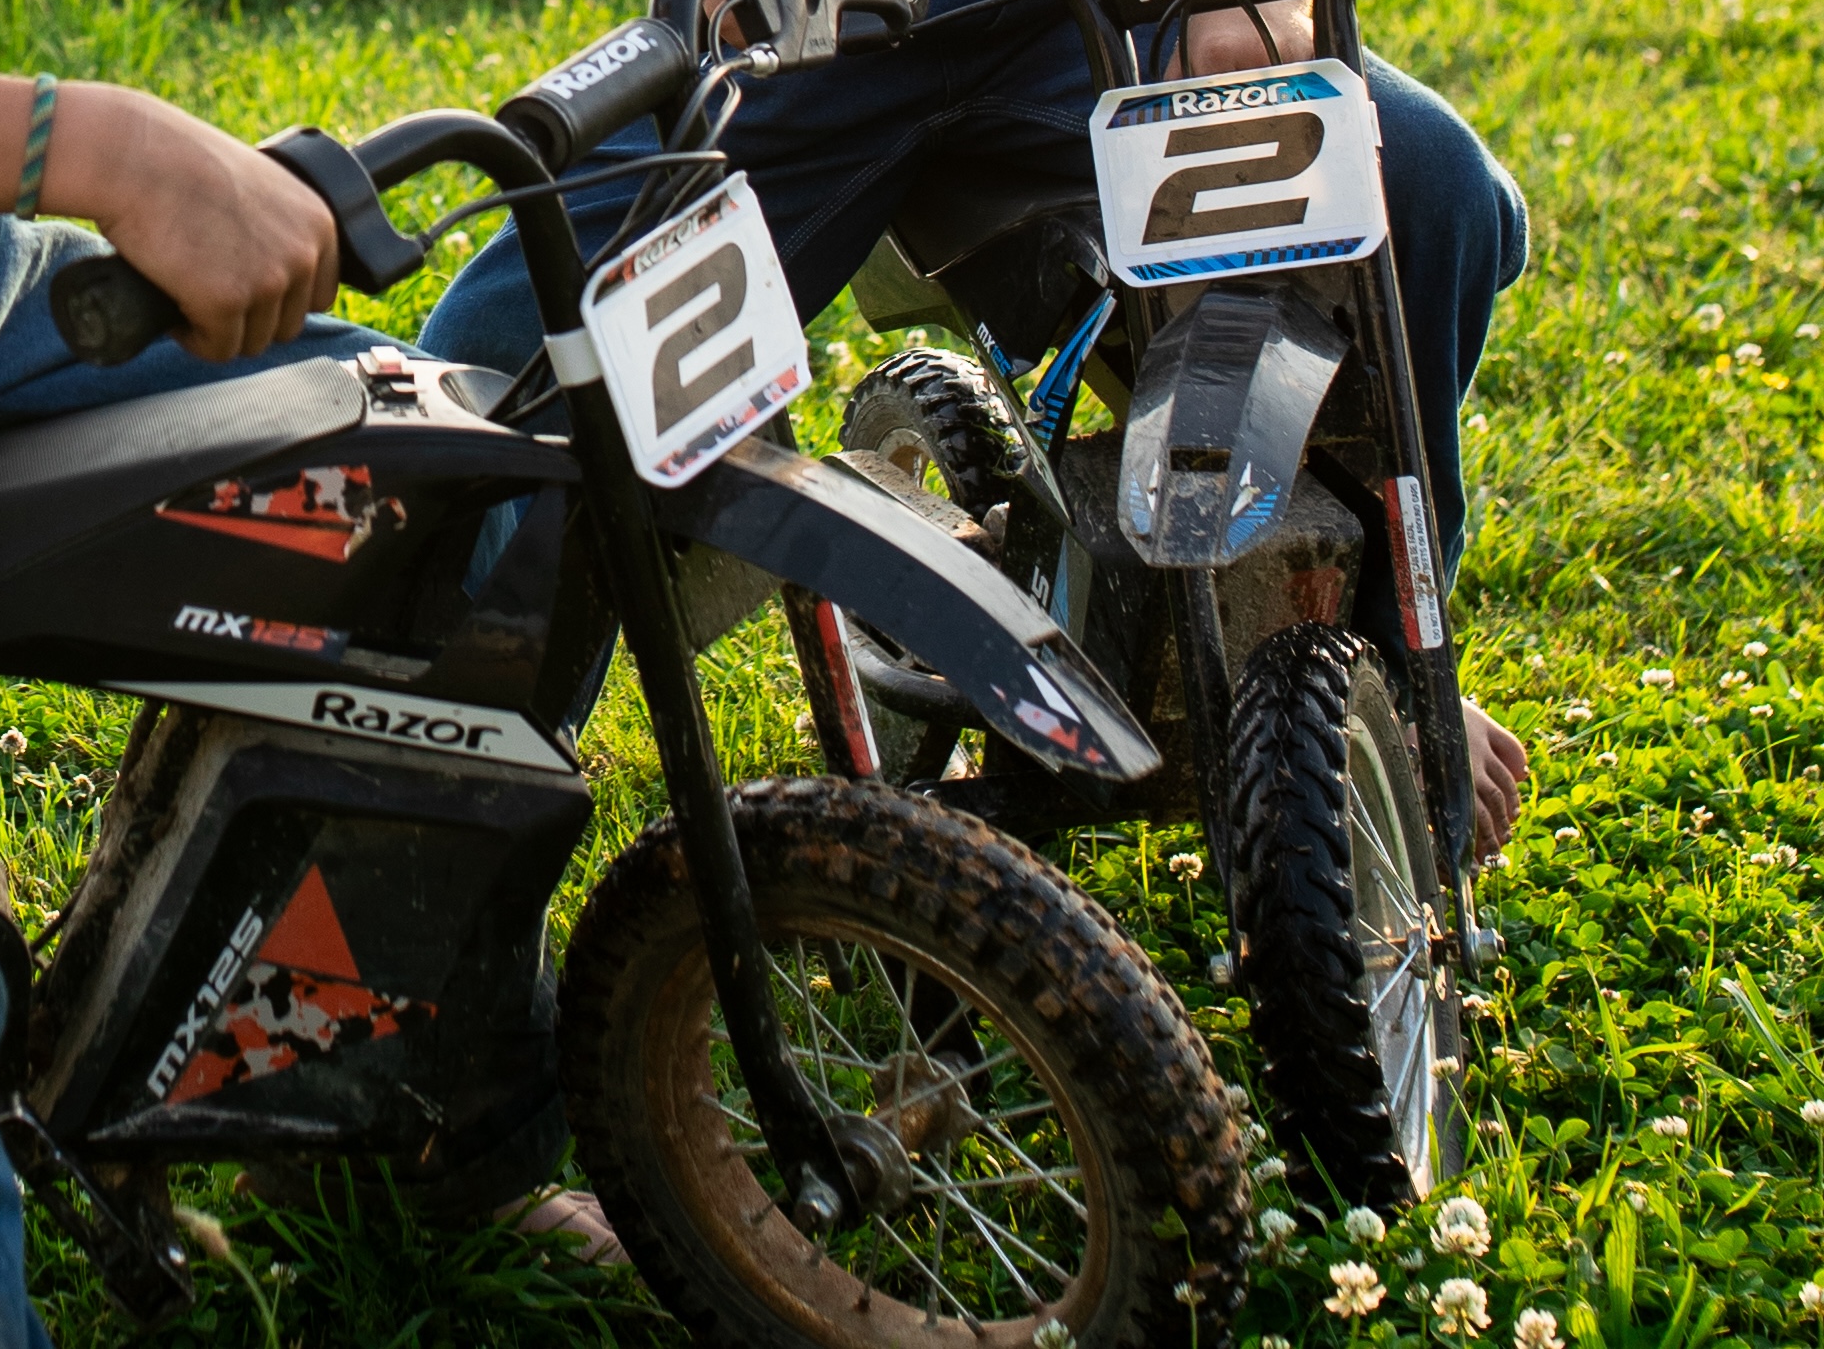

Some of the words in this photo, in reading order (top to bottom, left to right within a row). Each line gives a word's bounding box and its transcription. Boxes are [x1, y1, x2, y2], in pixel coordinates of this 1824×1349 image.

[541, 26, 652, 100] Razor
[1172, 82, 1288, 117] Razor
[1142, 111, 1326, 246] 2
[634, 207, 708, 276] Razor
[645, 241, 756, 437] 2
[1430, 612, 1439, 627] NOT
[312, 690, 503, 750] Razor
